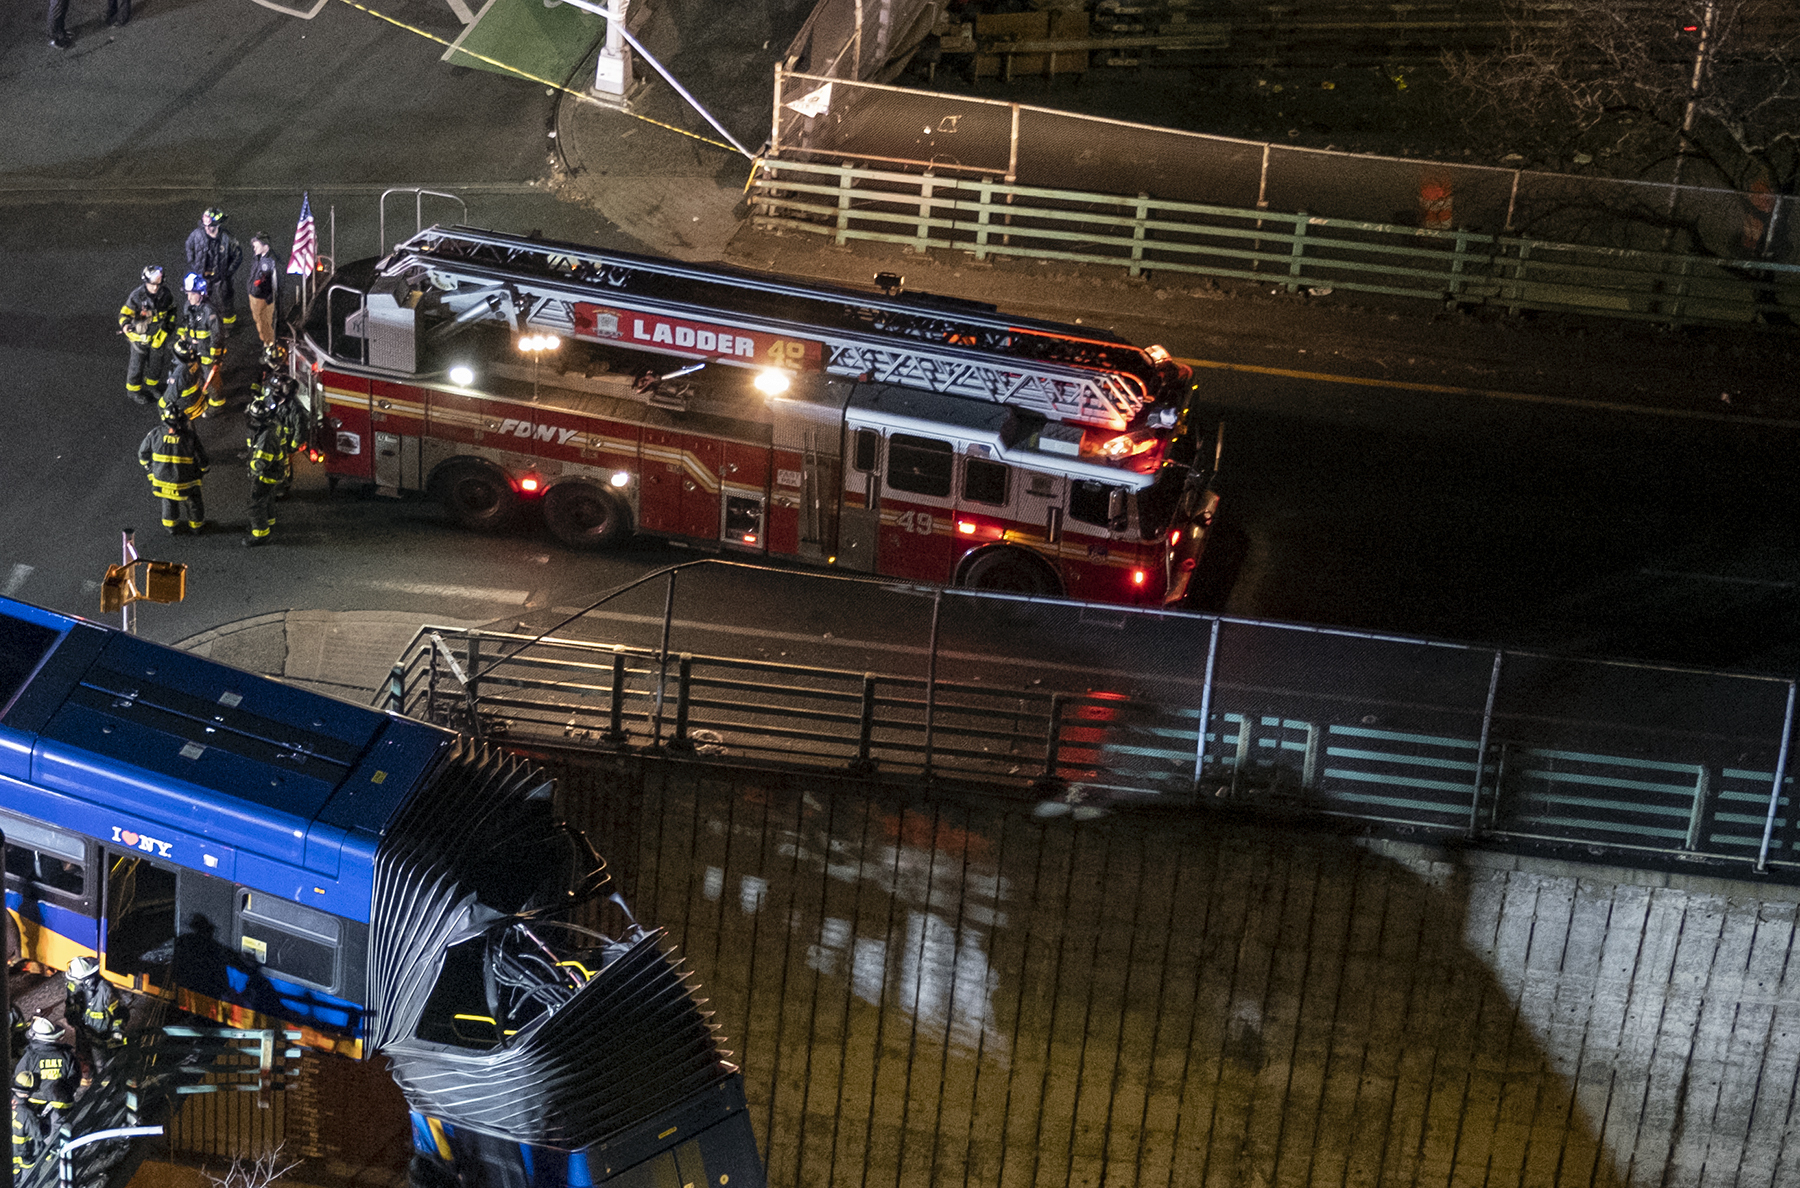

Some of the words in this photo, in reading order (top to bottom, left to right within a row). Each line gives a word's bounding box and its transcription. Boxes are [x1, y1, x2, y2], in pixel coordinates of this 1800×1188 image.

[633, 319, 754, 357] LADDER
[500, 418, 579, 445] FDNY
[898, 510, 932, 535] 49
[112, 826, 122, 842] I
